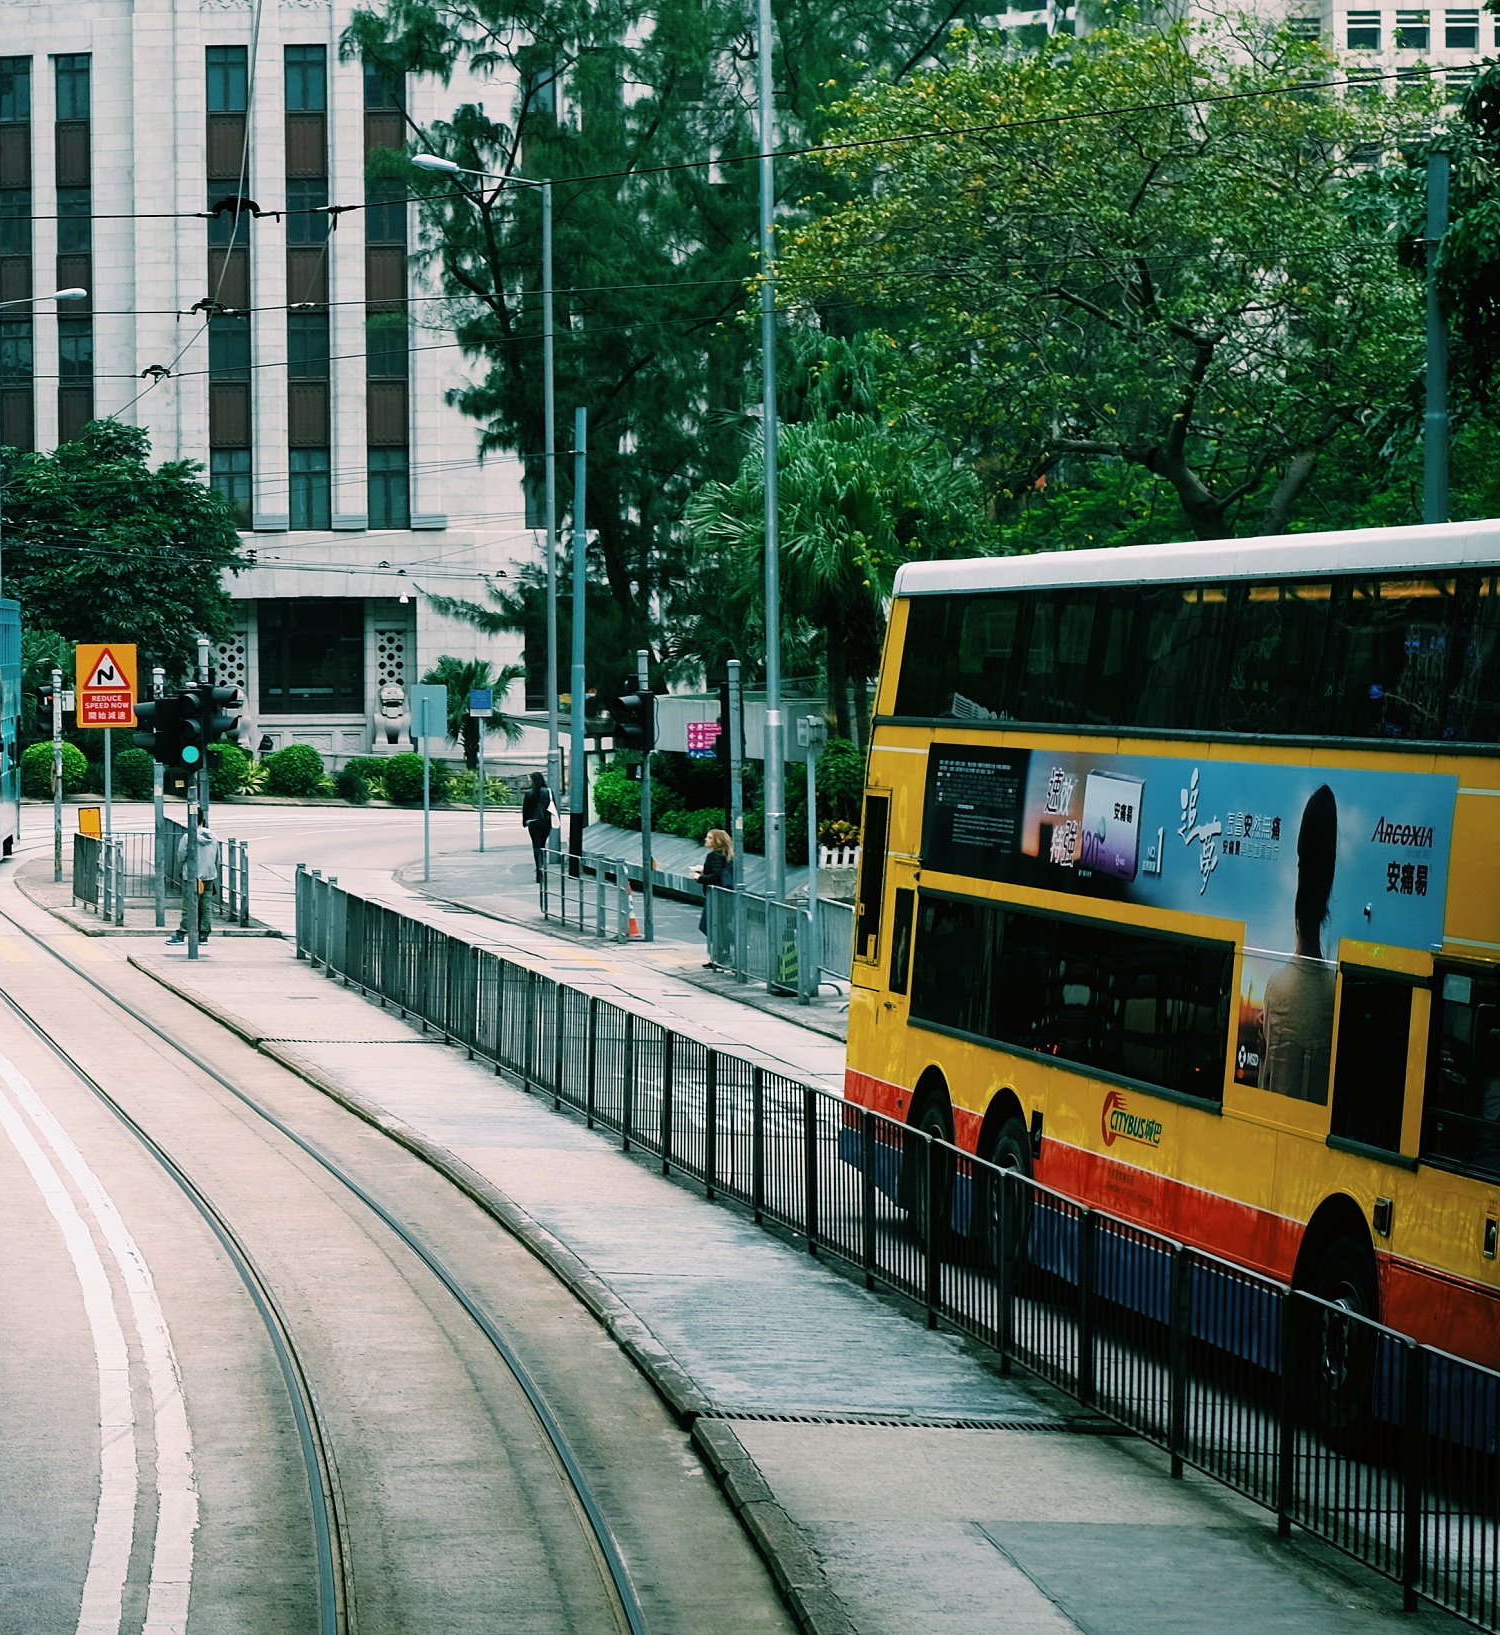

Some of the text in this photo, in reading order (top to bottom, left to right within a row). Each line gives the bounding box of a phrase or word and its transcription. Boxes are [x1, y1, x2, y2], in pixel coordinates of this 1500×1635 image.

[88, 711, 126, 720] 開始減速
[1043, 767, 1074, 816] 速效
[1113, 802, 1134, 823] 安痛易
[1050, 820, 1078, 867] 特強
[1371, 815, 1434, 848] ARCOXIA
[1386, 860, 1429, 897] 安痛易
[1110, 1110, 1163, 1144] CITYBUS 城巴
